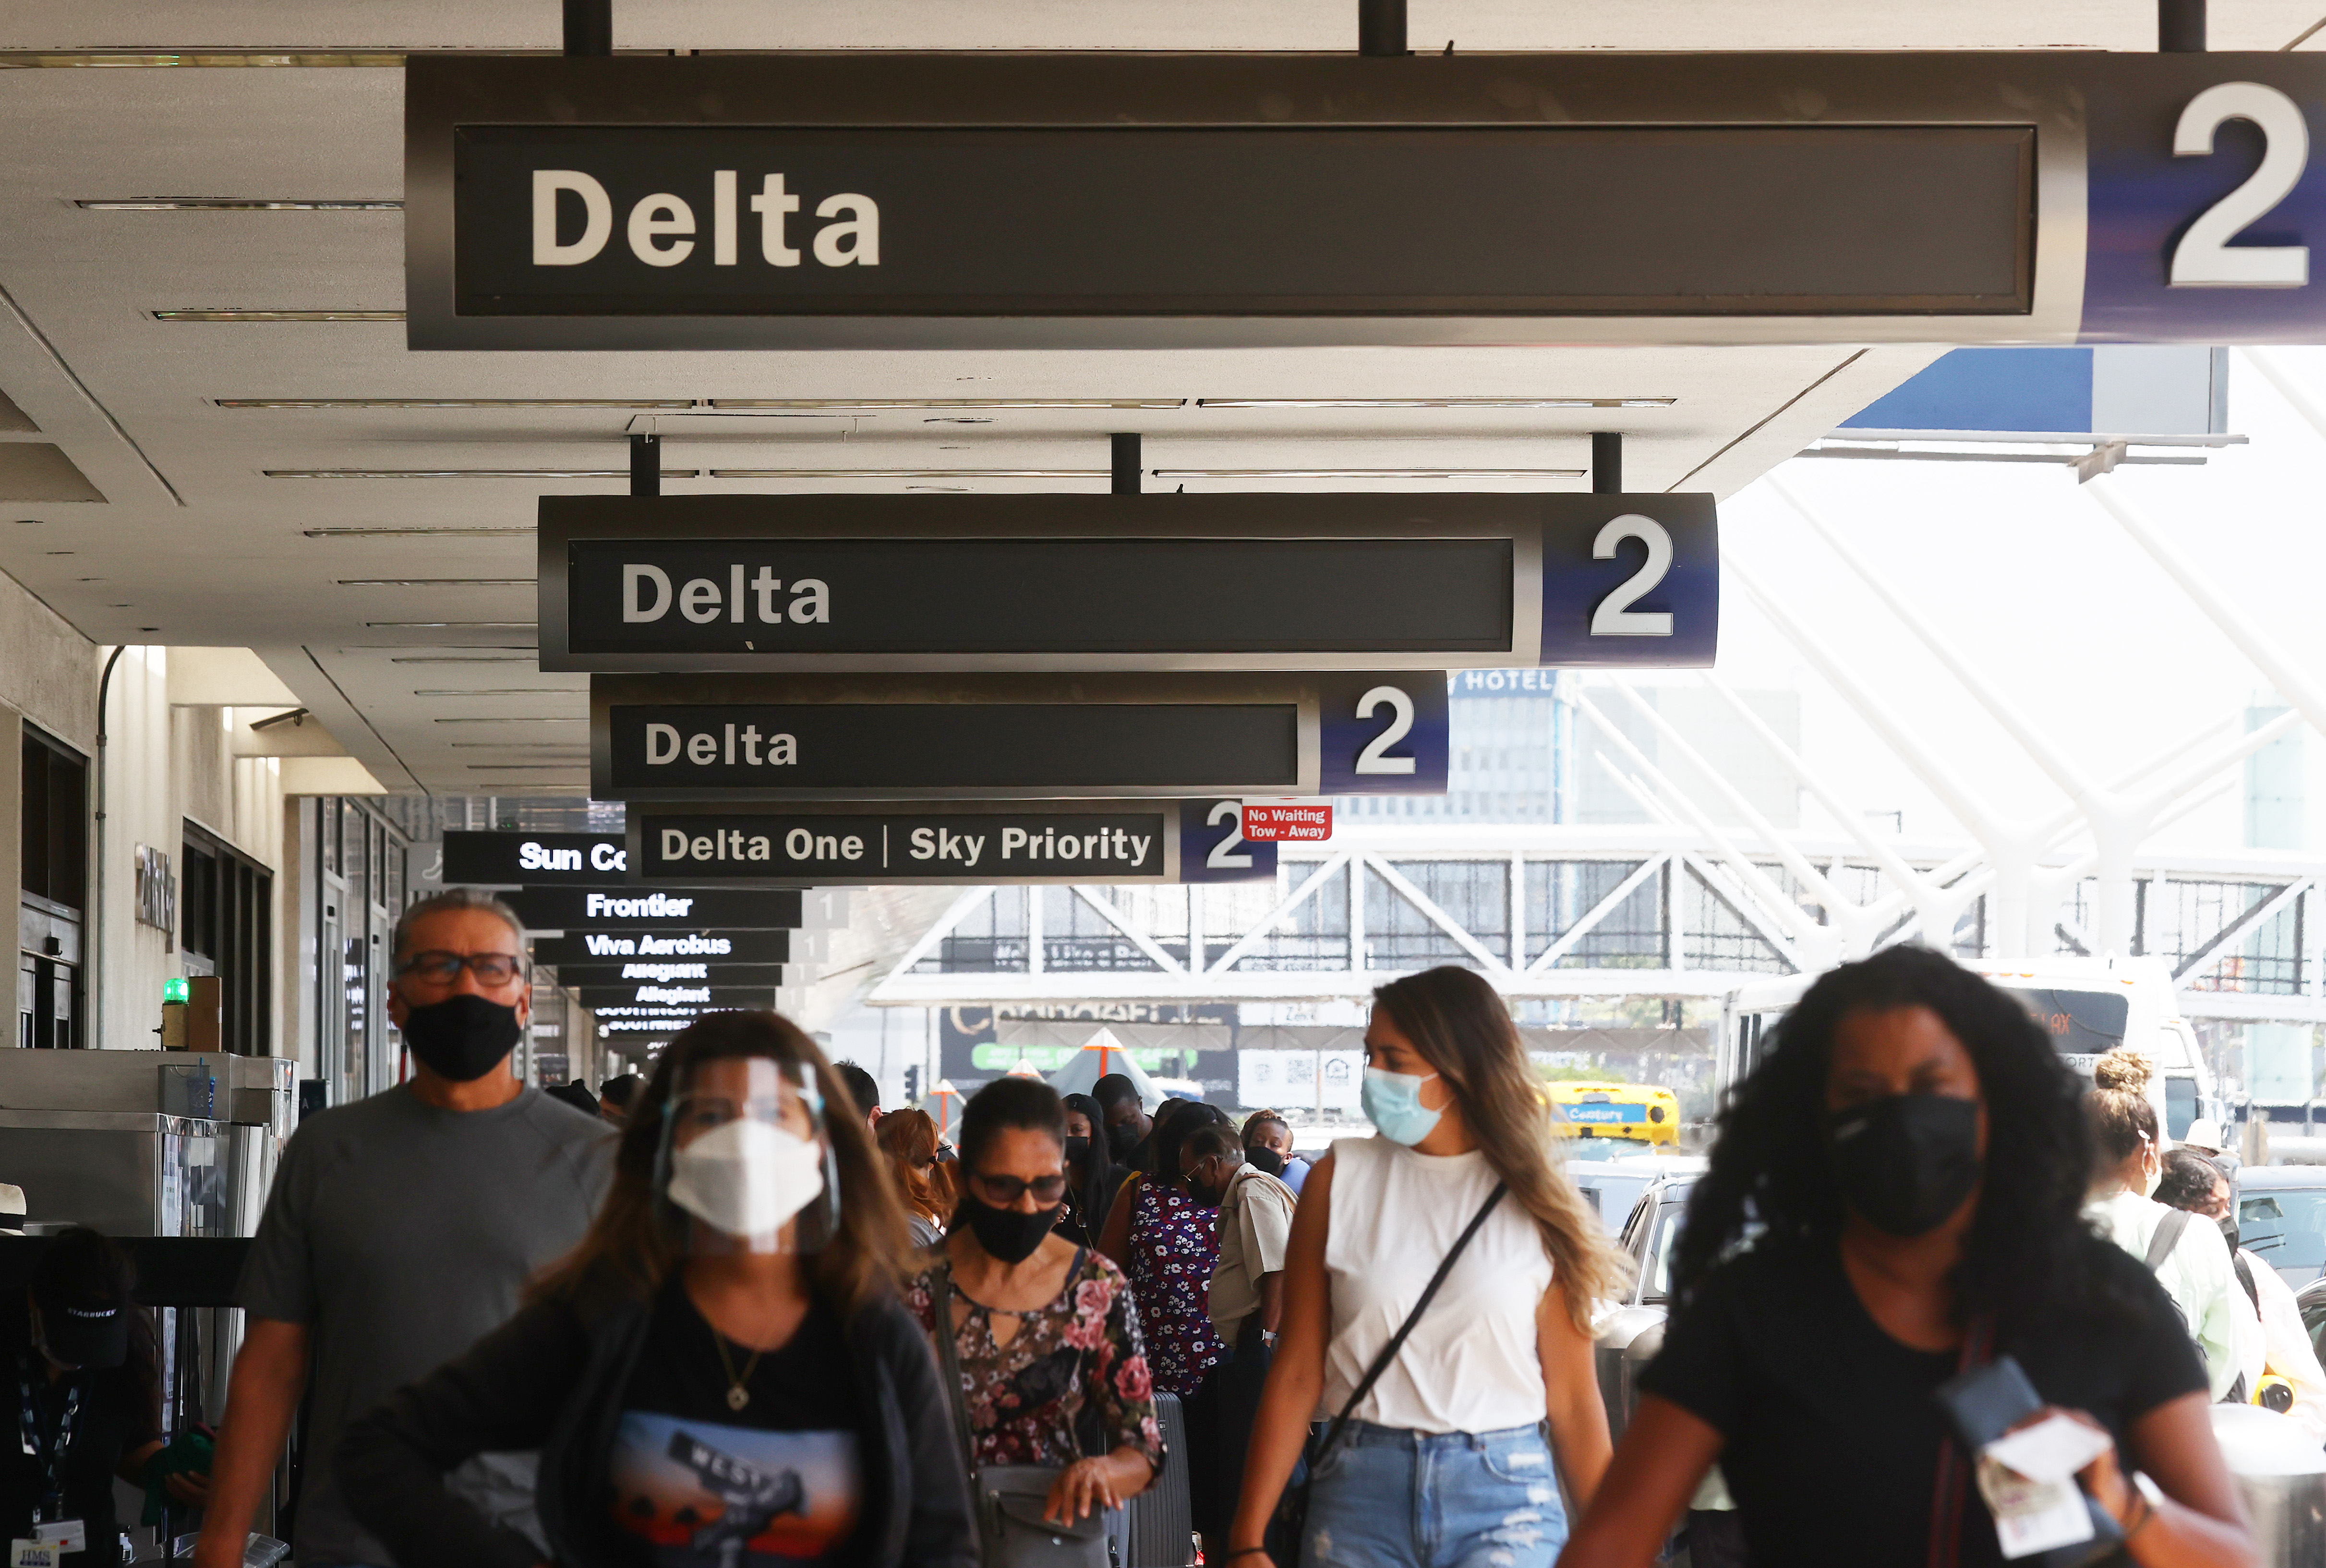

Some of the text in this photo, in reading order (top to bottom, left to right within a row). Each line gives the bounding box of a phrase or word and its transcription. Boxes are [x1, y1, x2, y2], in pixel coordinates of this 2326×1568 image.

[2169, 81, 2310, 287] 2
[532, 169, 880, 267] Delta
[1590, 514, 1674, 636] 2
[623, 564, 830, 624] Delta
[1466, 670, 1553, 690] HOTEL
[1355, 686, 1416, 774] 2
[646, 723, 797, 766] Delta
[1249, 809, 1326, 824] No Waiting
[1206, 800, 1253, 869] 2
[1249, 825, 1277, 837] Tow
[1288, 825, 1326, 840] Away
[519, 842, 582, 870] Sun
[661, 827, 1152, 867] Delta One Sky Priority
[586, 893, 694, 917] Frontier
[819, 892, 833, 921] 1
[584, 934, 732, 955] Viva Aerobus
[621, 963, 708, 983] Allegiant
[635, 986, 711, 1006] Allegiant
[67, 1307, 117, 1318] STARBUCKS
